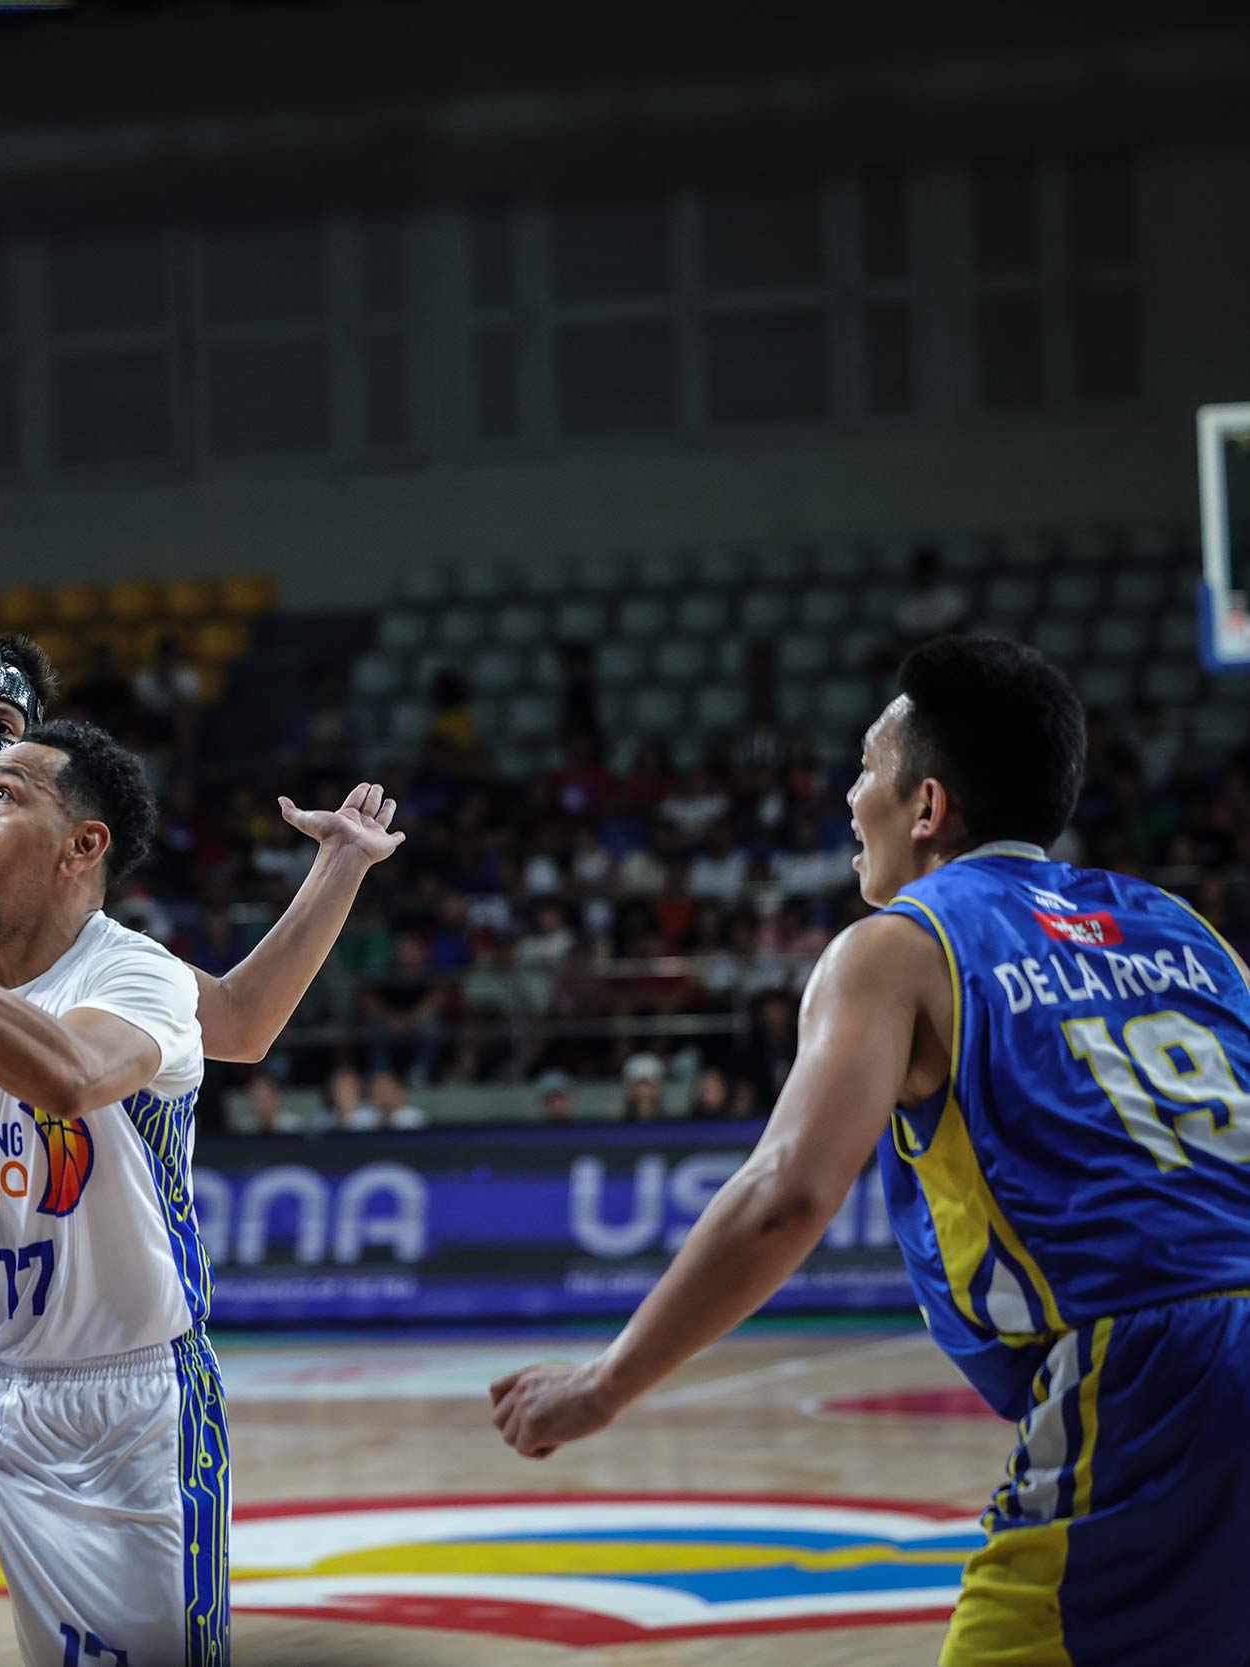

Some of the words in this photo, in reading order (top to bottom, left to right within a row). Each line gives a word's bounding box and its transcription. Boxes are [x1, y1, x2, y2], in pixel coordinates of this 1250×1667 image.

[994, 957, 1059, 1015] DE
[1049, 952, 1112, 1001] LA
[1103, 945, 1217, 1002] ROSA
[1060, 1010, 1250, 1174] 19
